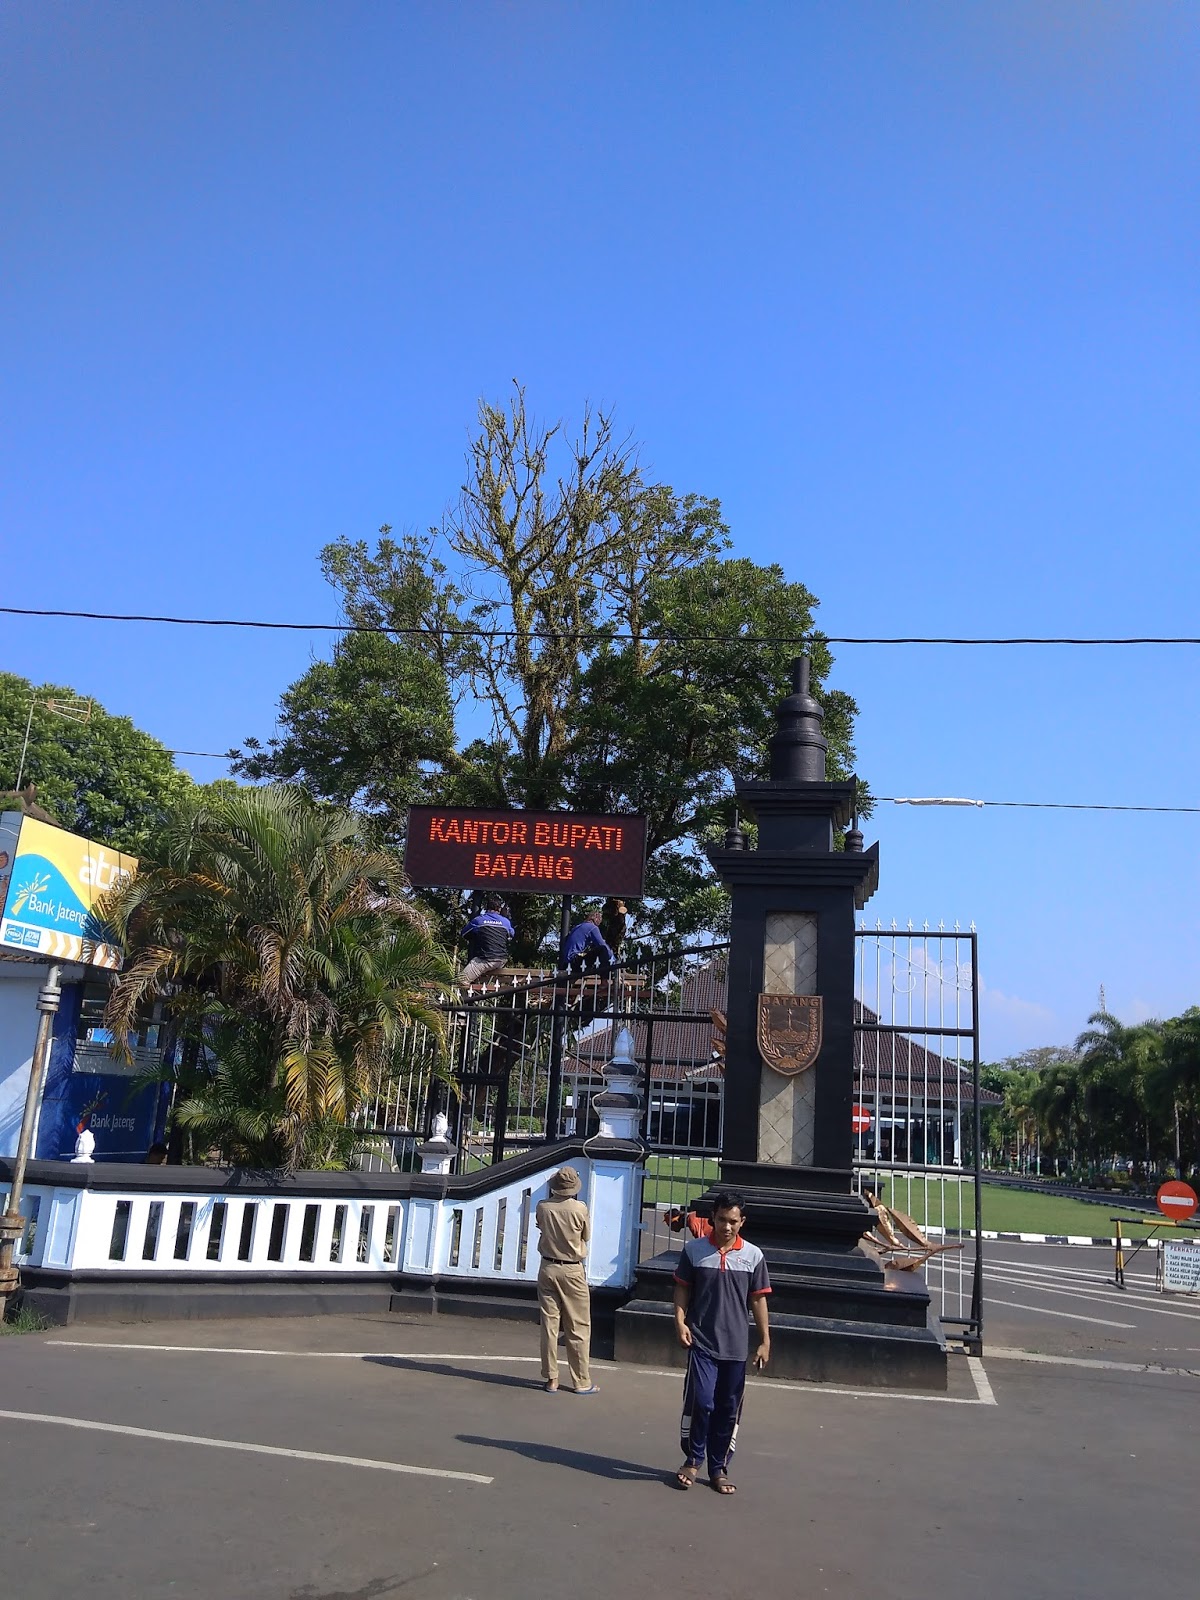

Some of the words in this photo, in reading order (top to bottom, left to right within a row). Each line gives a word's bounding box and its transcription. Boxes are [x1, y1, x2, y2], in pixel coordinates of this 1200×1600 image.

[429, 817, 528, 845] KANTOR
[534, 822, 622, 851] BUPATI
[474, 853, 573, 880] BATANG
[28, 894, 55, 916] Bank
[55, 902, 88, 929] Jateng
[762, 996, 819, 1007] BATANG
[90, 1113, 111, 1128] Bank
[110, 1115, 136, 1132] Jateng
